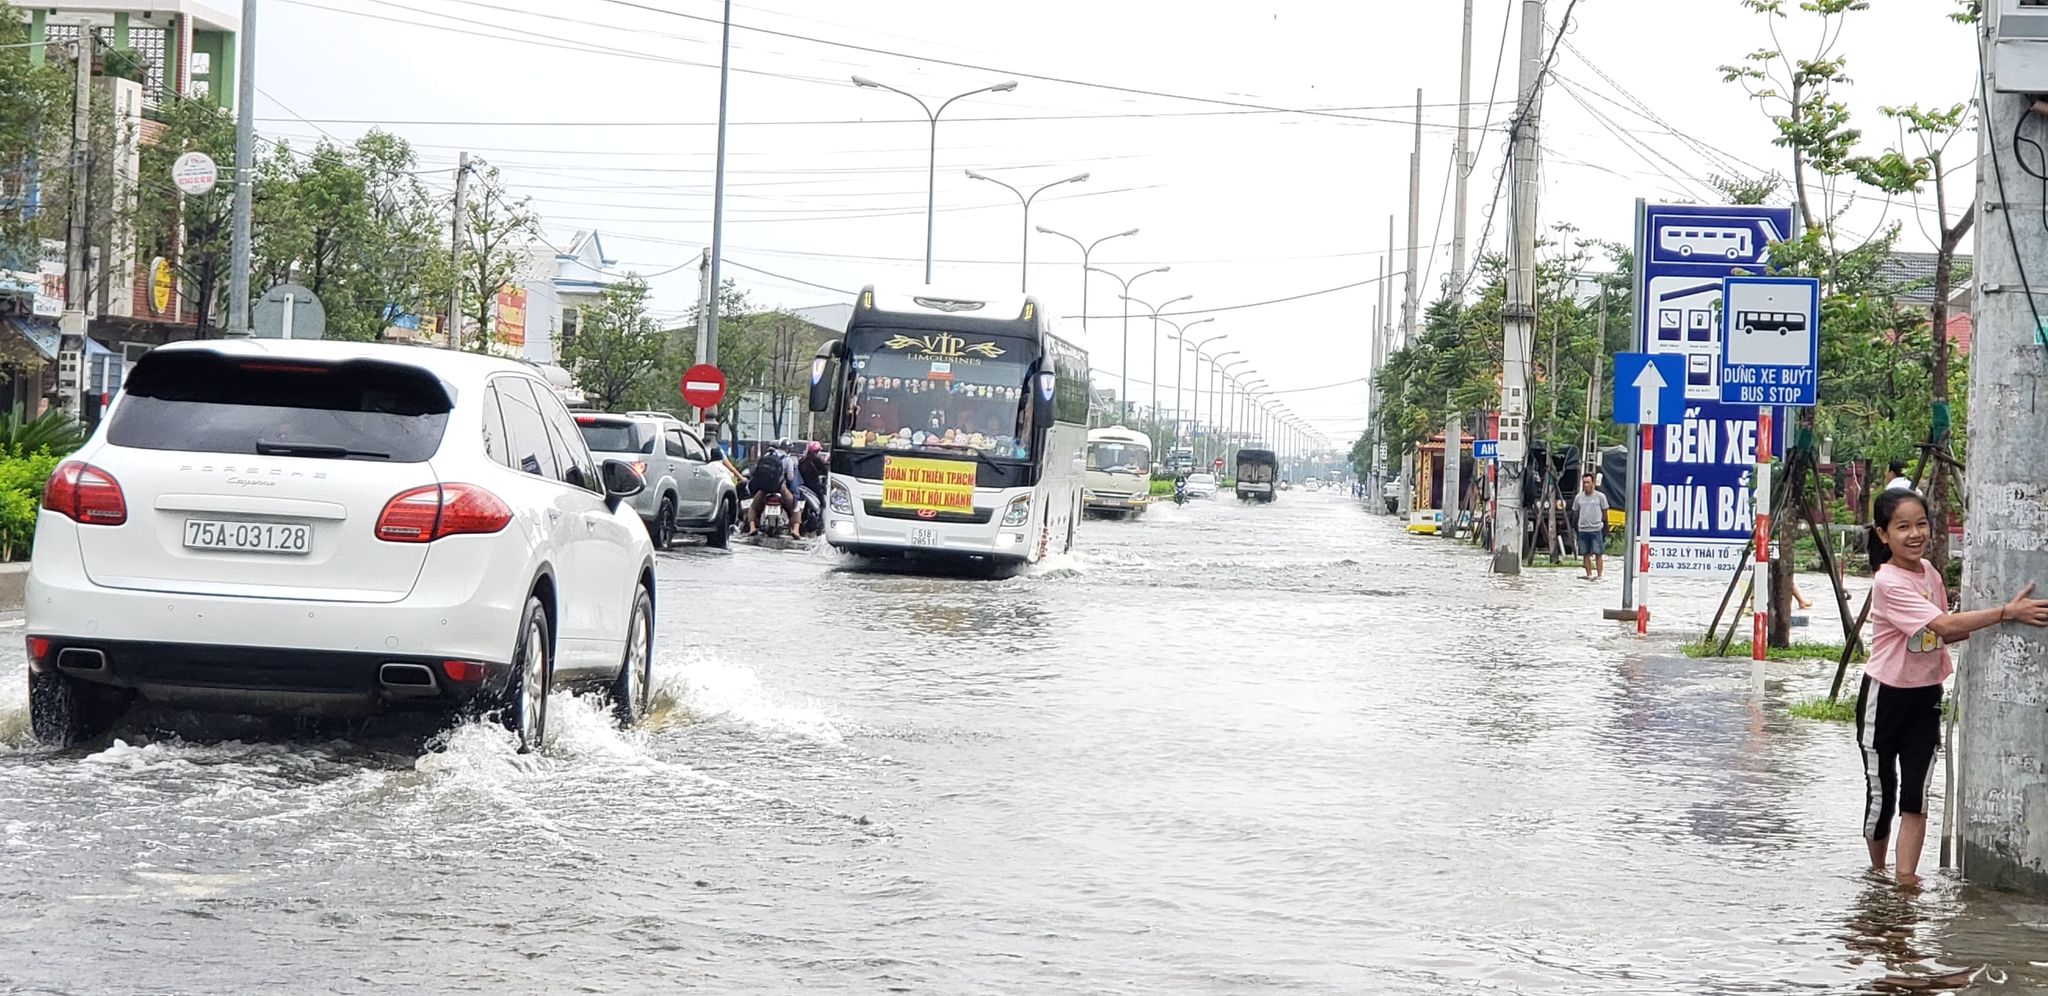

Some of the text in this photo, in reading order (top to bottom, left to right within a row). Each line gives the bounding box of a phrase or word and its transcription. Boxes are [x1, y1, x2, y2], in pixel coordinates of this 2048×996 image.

[923, 332, 966, 356] VIP
[907, 353, 982, 365] LIMOUSINES
[1723, 365, 1813, 385] DỪNG XE BUÝT
[1741, 386, 1802, 402] BUS STOP
[1665, 407, 1757, 464] BẾN XE
[179, 465, 327, 479] PORSCHE
[1651, 476, 1710, 530] PHÍA
[189, 522, 306, 550] 75A-031.28
[918, 528, 931, 538] 51B
[1648, 547, 1658, 557] C:
[1661, 548, 1678, 557] 132
[1680, 546, 1692, 558] LÝ
[1694, 546, 1715, 559] THÁI
[1656, 561, 1674, 569] 0234
